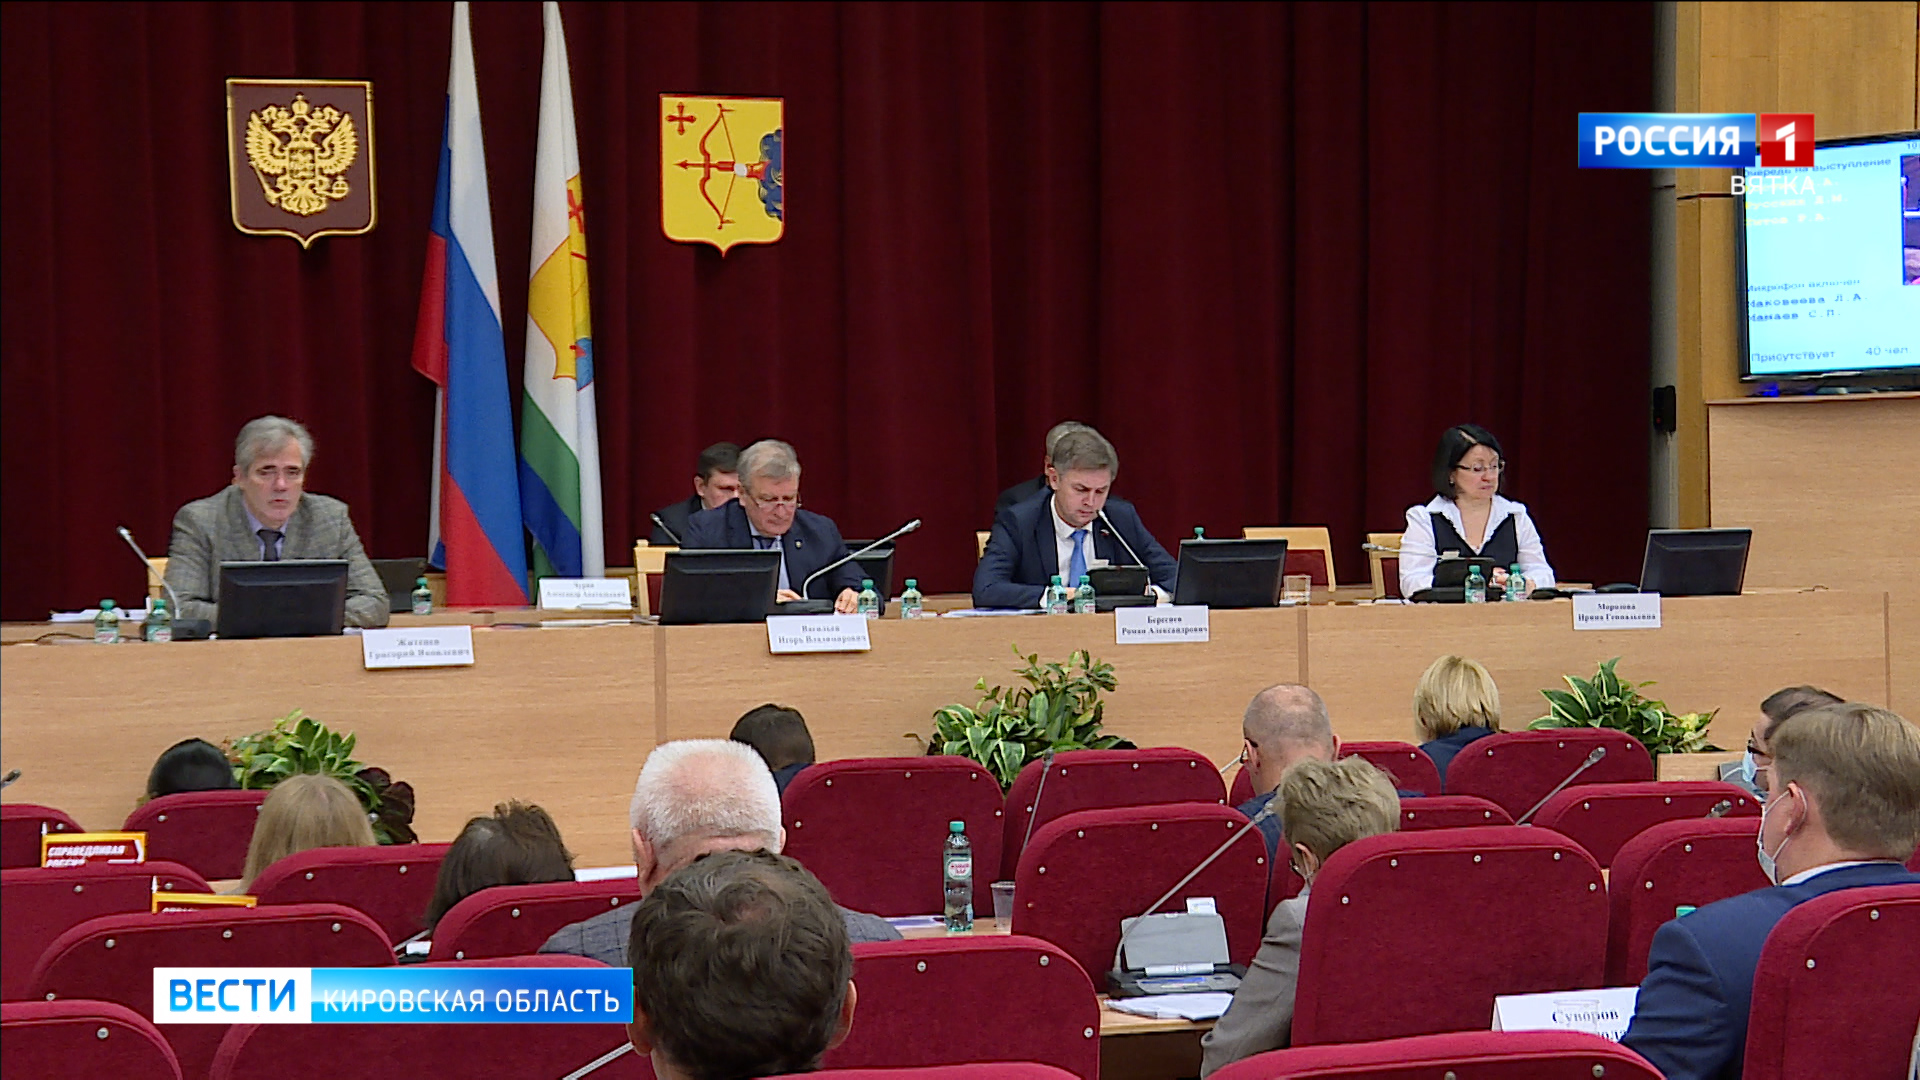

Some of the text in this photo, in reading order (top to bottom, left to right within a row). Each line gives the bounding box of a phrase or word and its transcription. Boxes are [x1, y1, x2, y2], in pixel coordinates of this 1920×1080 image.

[1812, 158, 1891, 172] выступление
[1751, 351, 1836, 363] Присутствует
[1865, 345, 1881, 356] 40
[1552, 1010, 1619, 1027] Суворов
